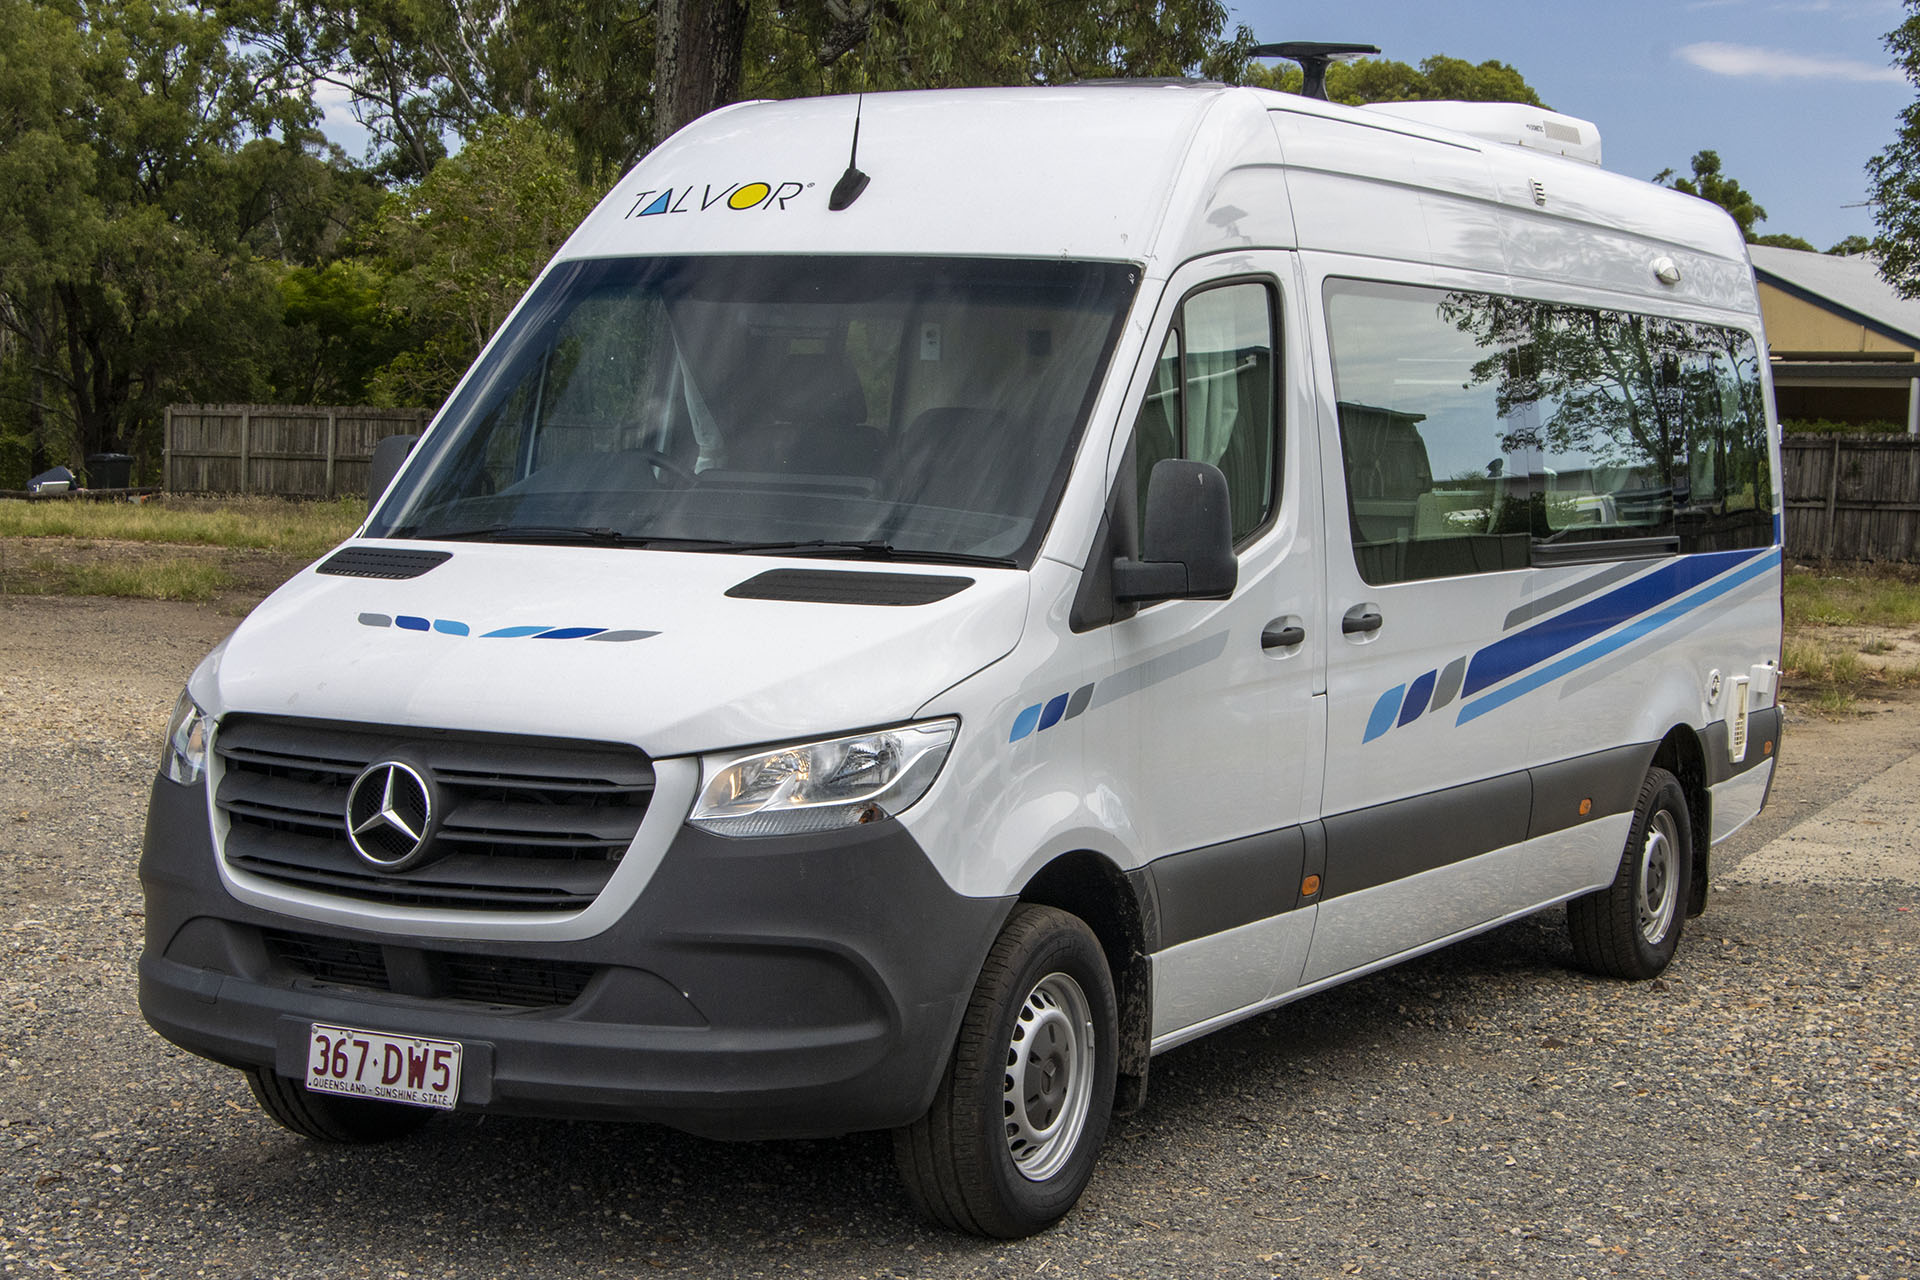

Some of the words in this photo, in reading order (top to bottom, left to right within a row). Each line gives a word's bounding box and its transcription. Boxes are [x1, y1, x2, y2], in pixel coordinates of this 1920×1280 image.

[624, 182, 804, 220] TALVOR
[313, 1077, 367, 1094] QUEENSLAND
[375, 1086, 418, 1102] SUNSHINE
[421, 1092, 449, 1106] STATE
